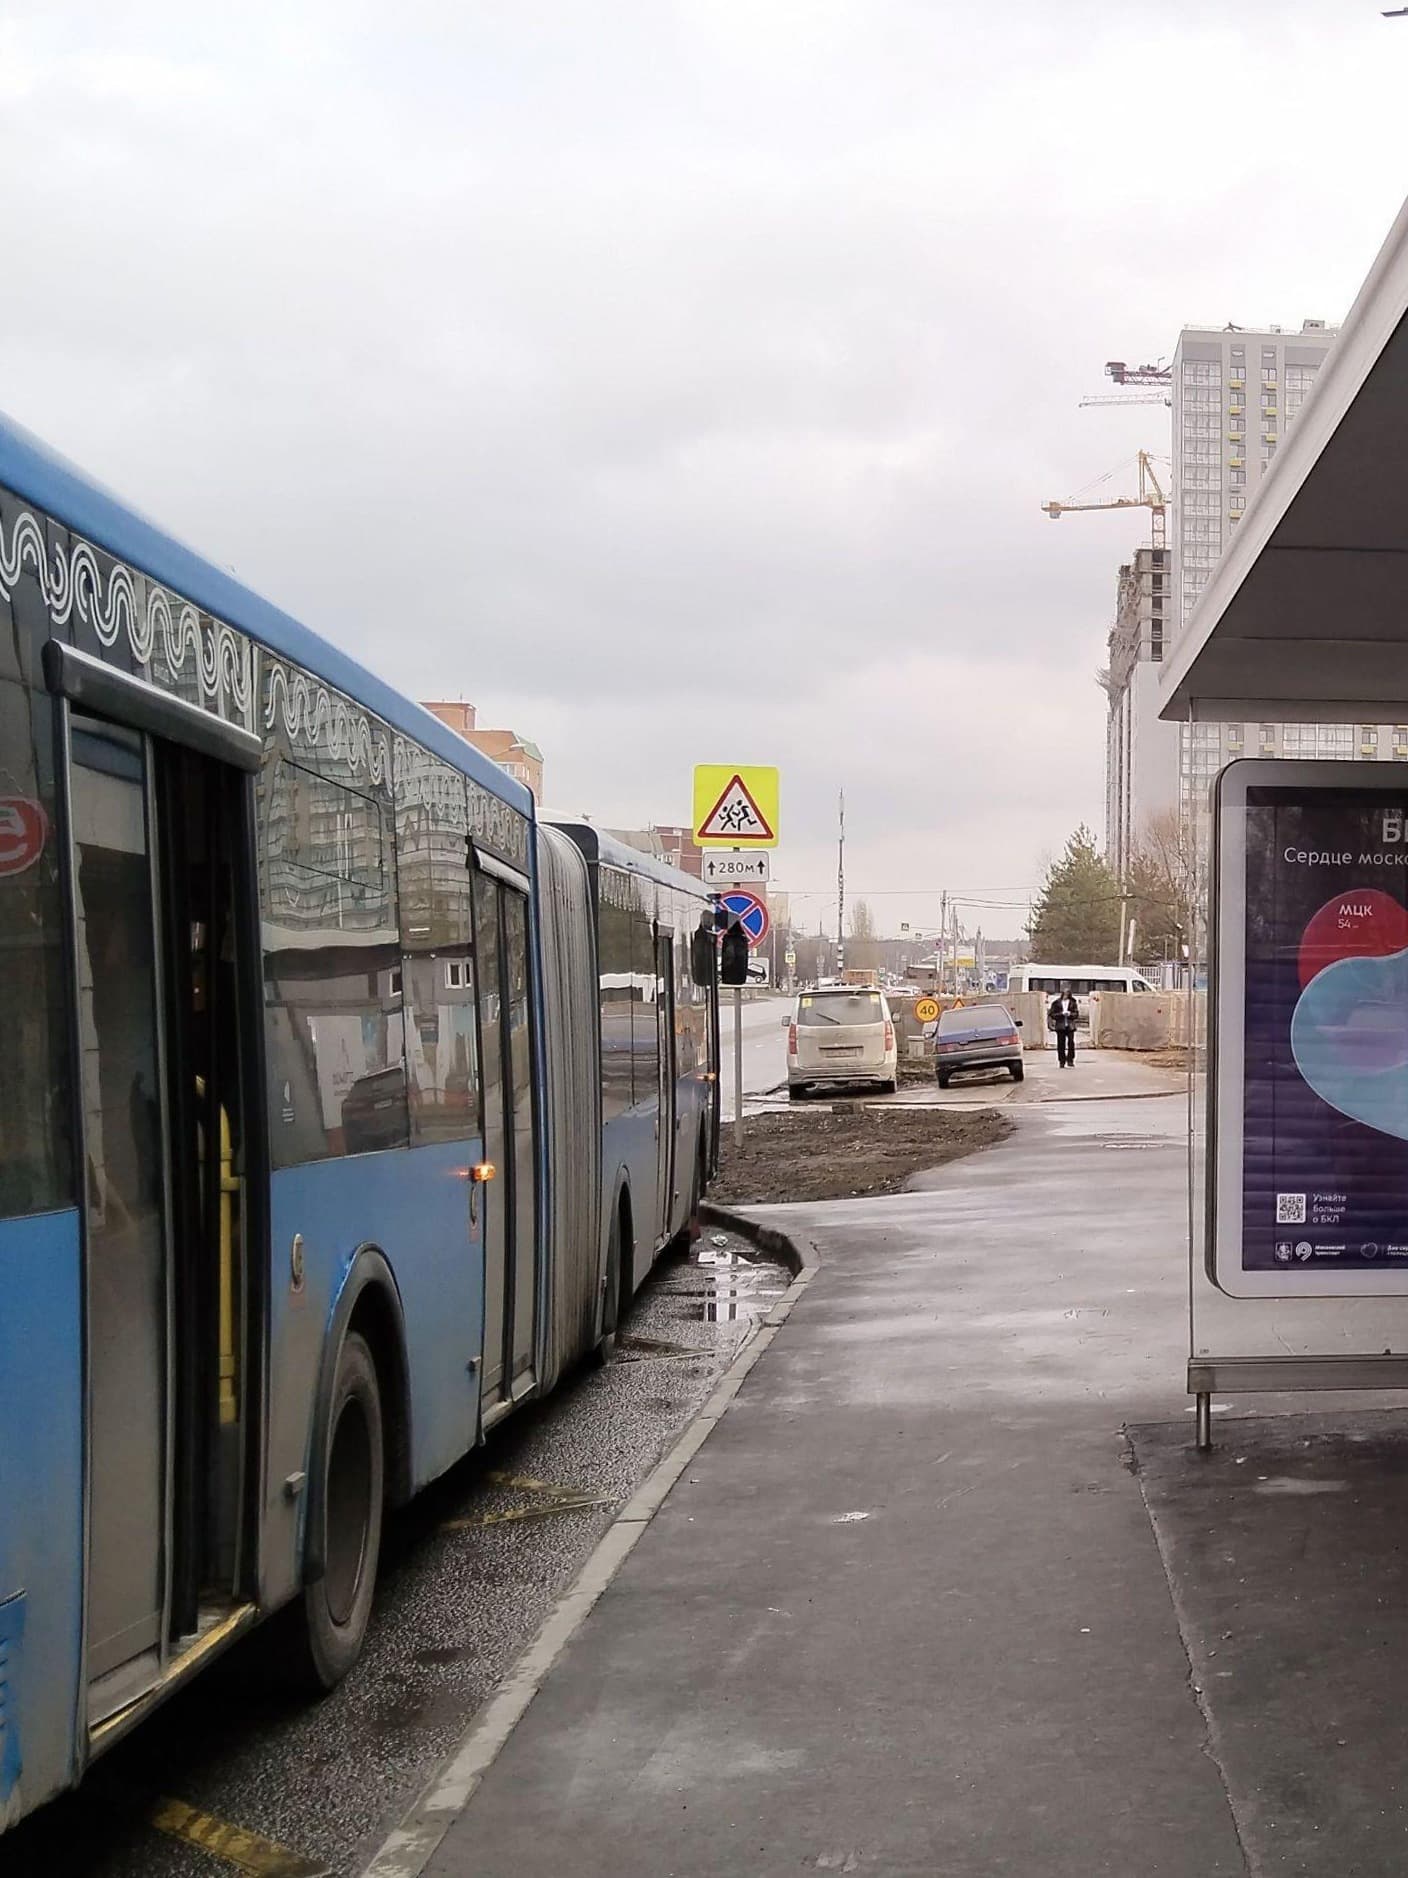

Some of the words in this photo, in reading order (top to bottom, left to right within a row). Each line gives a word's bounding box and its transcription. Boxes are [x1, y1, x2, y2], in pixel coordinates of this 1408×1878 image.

[1284, 847, 1353, 867] Сердце
[1339, 904, 1373, 918] МЦК
[1337, 918, 1351, 929] 54
[920, 1005, 935, 1016] 40
